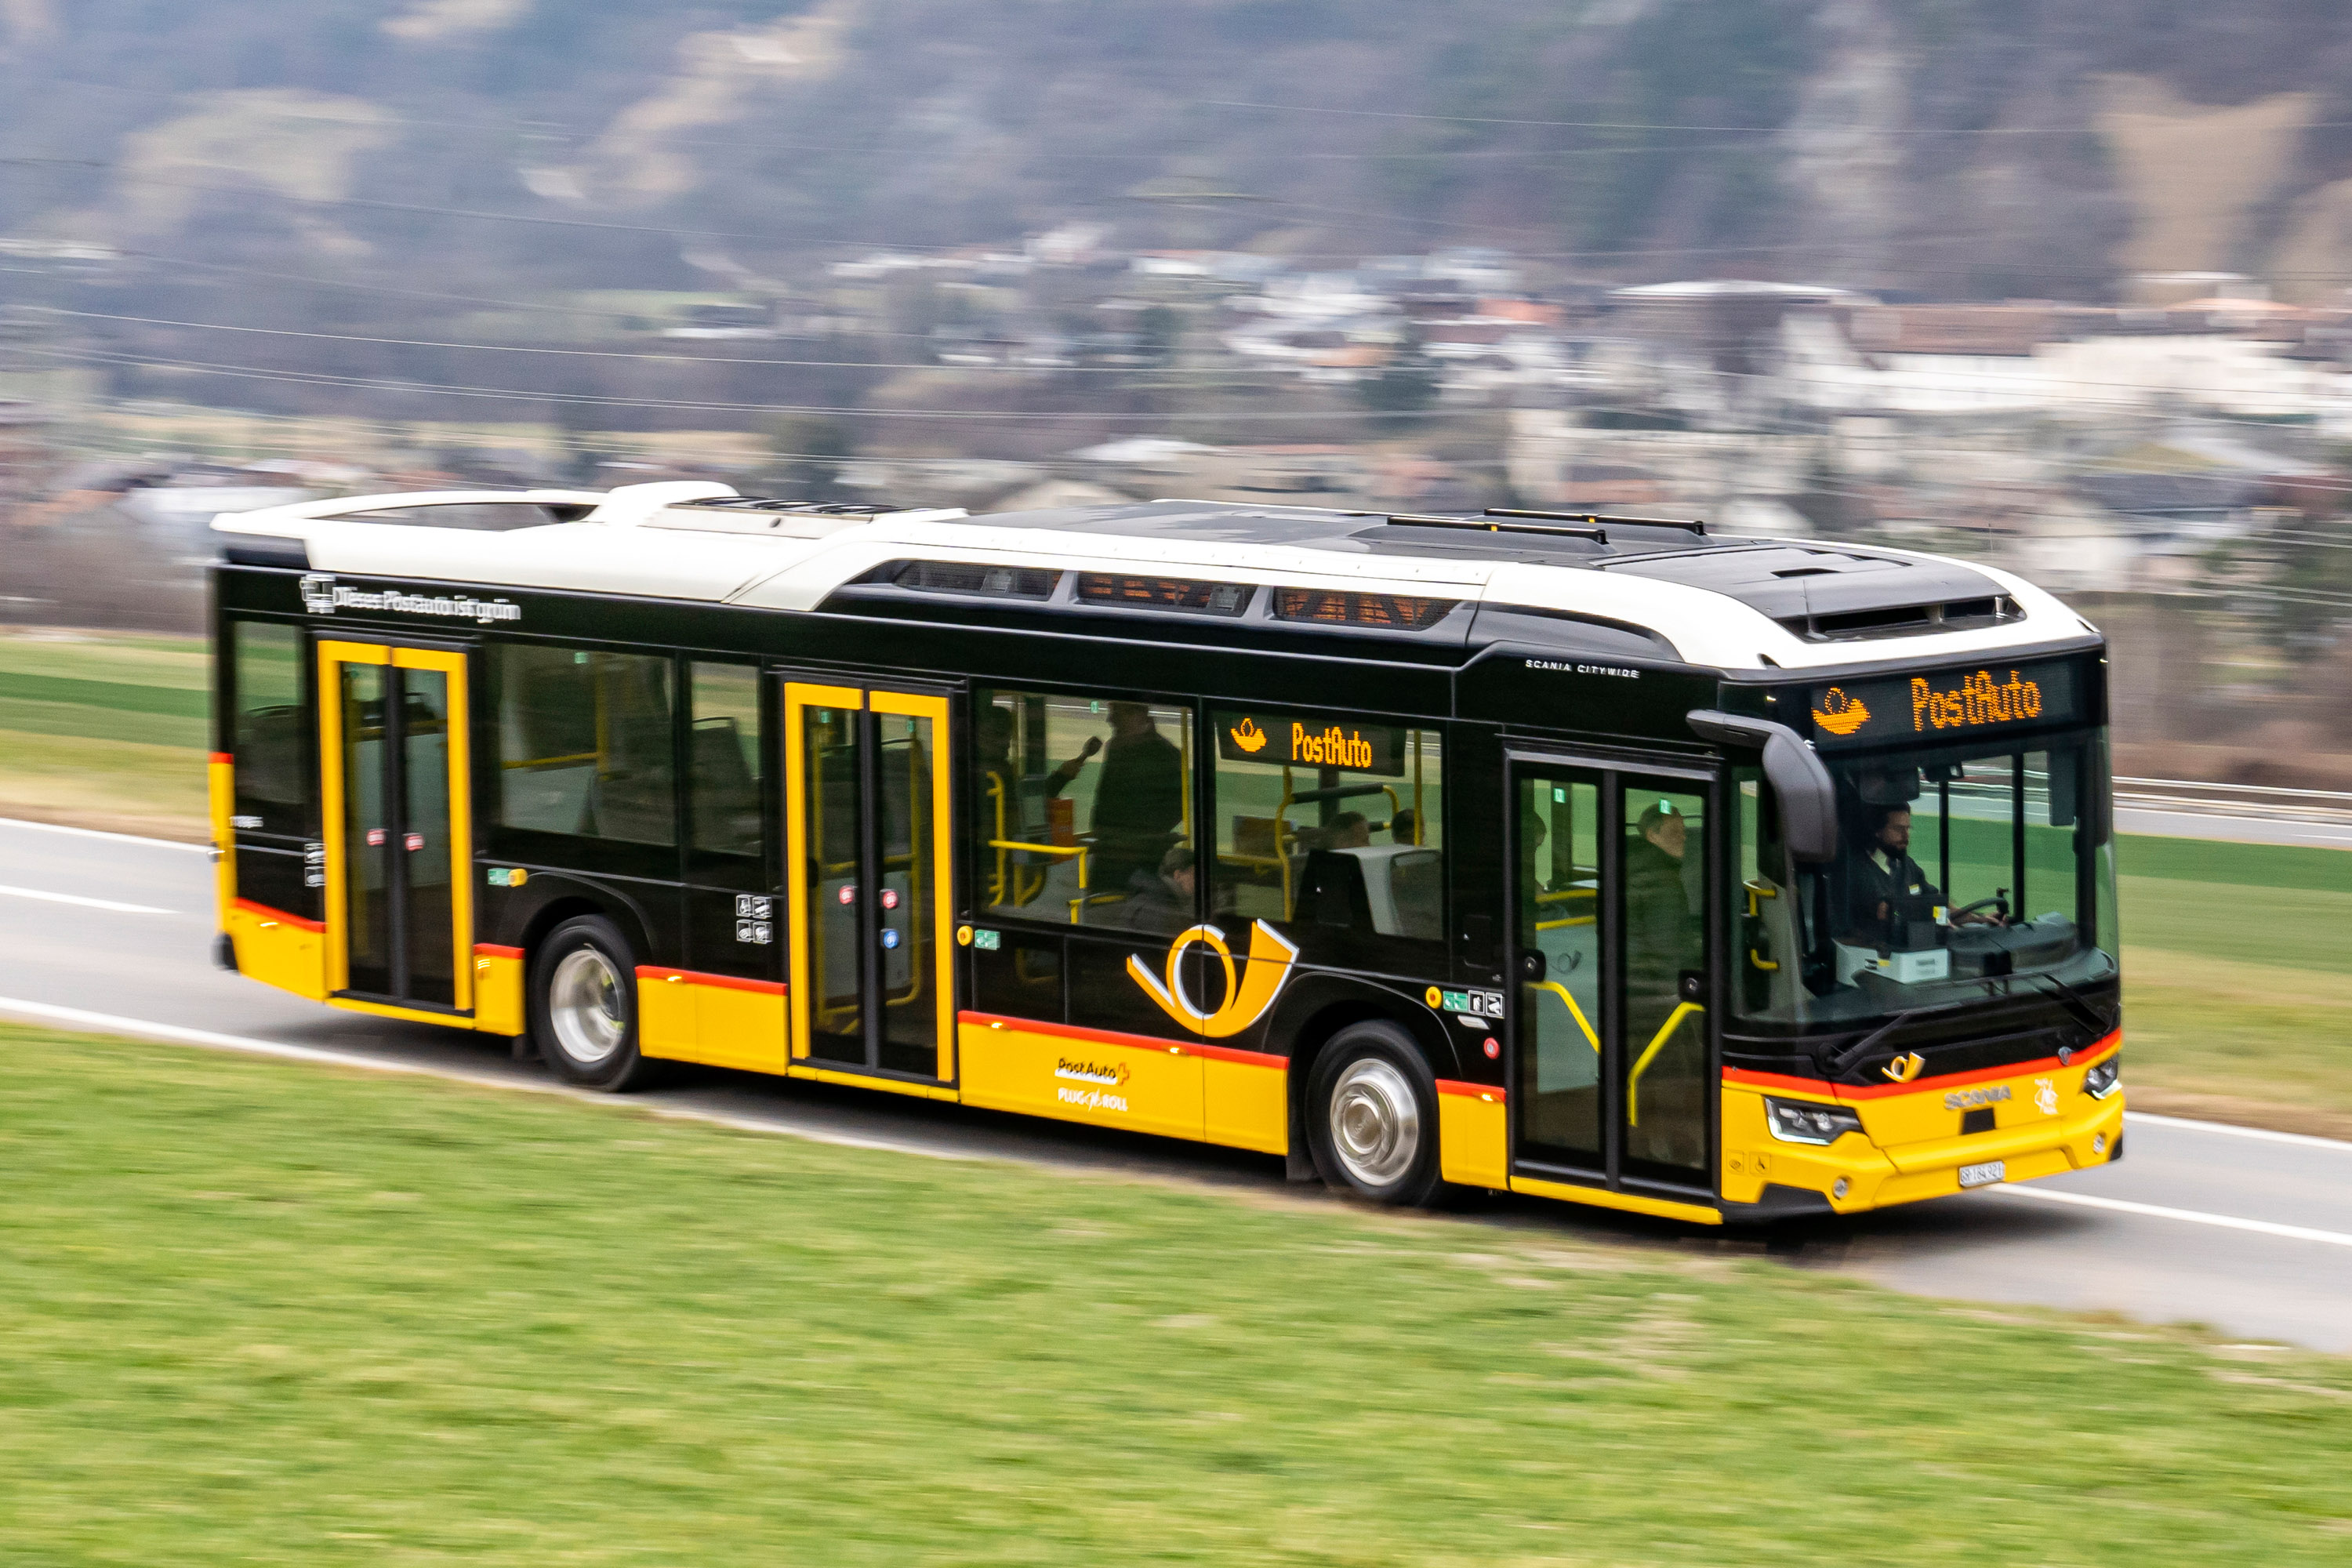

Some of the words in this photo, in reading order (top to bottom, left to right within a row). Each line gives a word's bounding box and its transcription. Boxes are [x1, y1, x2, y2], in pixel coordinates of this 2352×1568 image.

[1525, 659, 1573, 672] SCANIA
[1577, 665, 1639, 679] CITYWIDE
[1911, 670, 2042, 731] PostAuto
[1292, 722, 1372, 768] PostAuto
[1058, 1087, 1085, 1105] PLUG
[1102, 1094, 1128, 1112] ROLL
[1944, 1085, 2012, 1110] SCANIA
